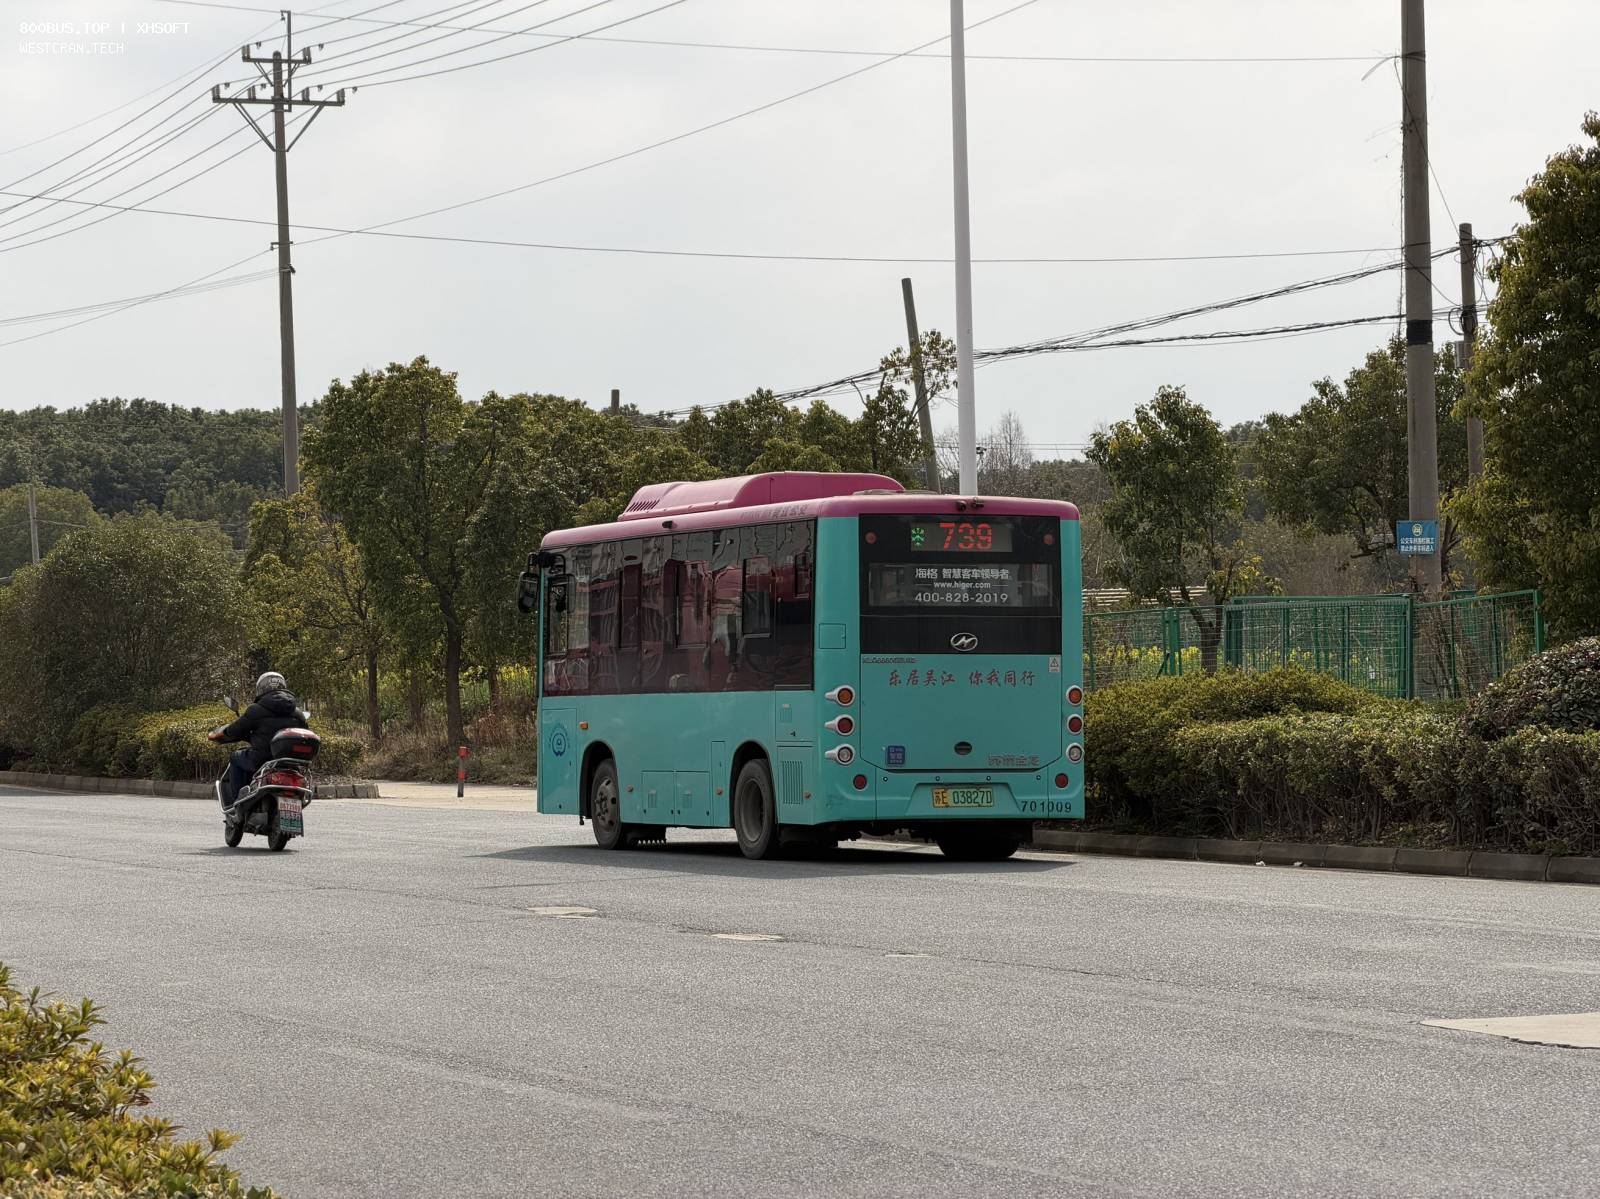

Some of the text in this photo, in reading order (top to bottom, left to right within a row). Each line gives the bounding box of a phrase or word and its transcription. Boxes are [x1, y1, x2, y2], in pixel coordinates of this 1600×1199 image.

[939, 522, 993, 552] 739
[942, 568, 1009, 580] 智慧客车领导者
[933, 581, 991, 589] www.higer.com
[914, 592, 1008, 604] 400-828-2019
[889, 669, 1037, 687] 乐居吴江 你我同行
[1021, 800, 1073, 814] 701009
